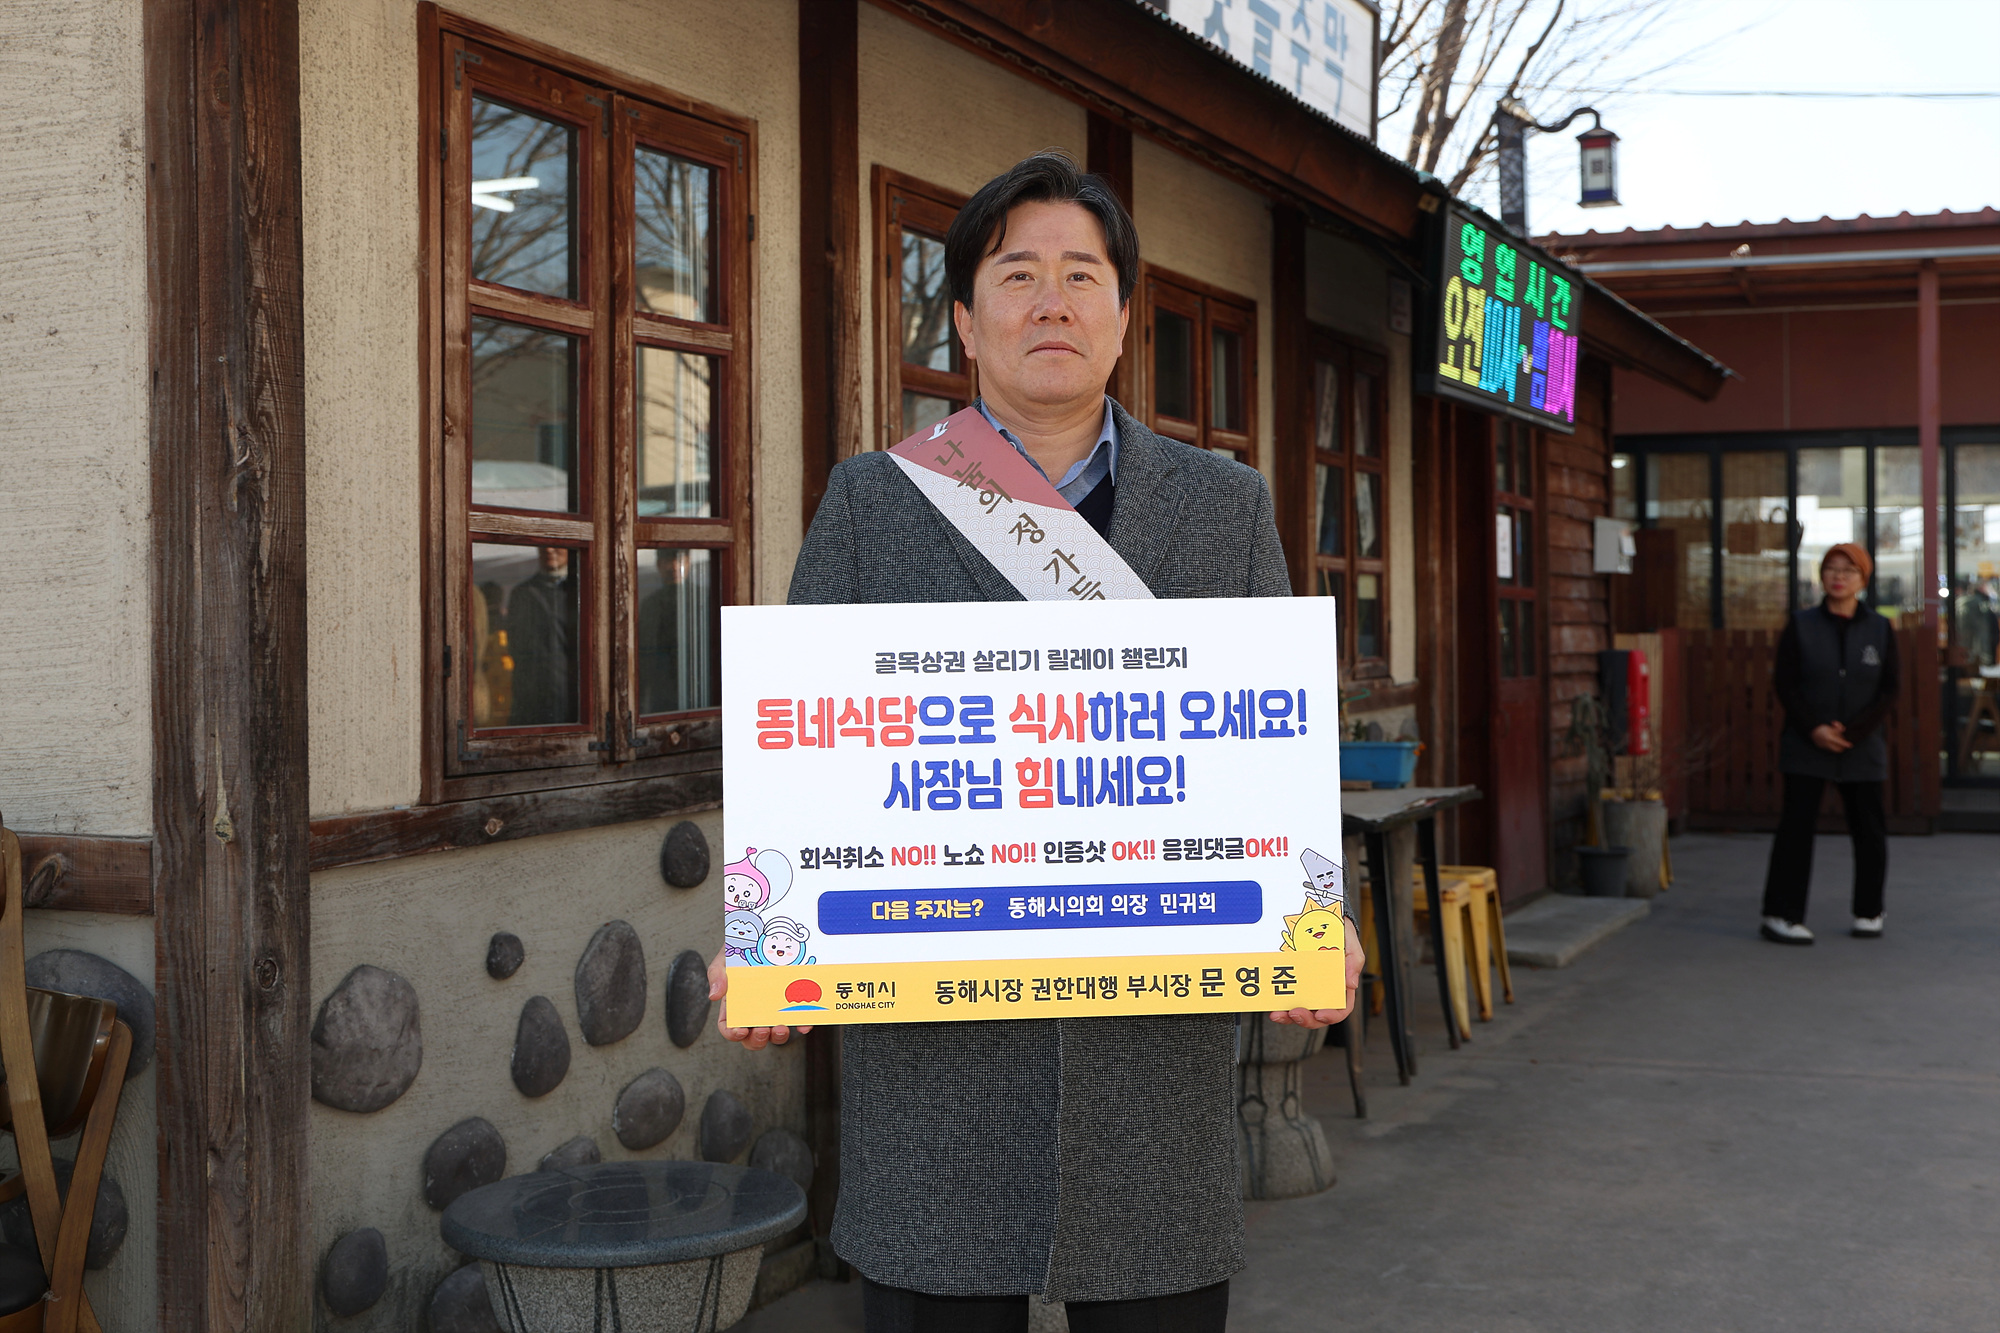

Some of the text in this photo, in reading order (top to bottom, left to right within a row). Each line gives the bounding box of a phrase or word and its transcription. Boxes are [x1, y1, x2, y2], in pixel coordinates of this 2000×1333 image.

[934, 440, 1013, 514] 나눔의
[874, 646, 1188, 675] 골목상권 살리기 릴레이 챌린지
[755, 688, 1308, 750] 동네식당으로 식사하러 오세요!
[882, 754, 1187, 812] 사장님 힘내세요!
[799, 845, 885, 870] 회식취소
[891, 844, 937, 866] NO!!
[943, 843, 985, 866] 노쇼
[991, 841, 1037, 864] NO!!
[1043, 839, 1107, 864] 인증샷
[1111, 838, 1156, 861] OK!!
[871, 891, 1217, 921] 다음 주자는? 동해시의회 의장 민귀희
[835, 980, 896, 1000] 동해시
[835, 1000, 896, 1010] DONGHAE CITY
[934, 977, 1024, 1005] 동해시장
[1030, 974, 1119, 1002] 권한대행
[1126, 973, 1192, 999] 부시장
